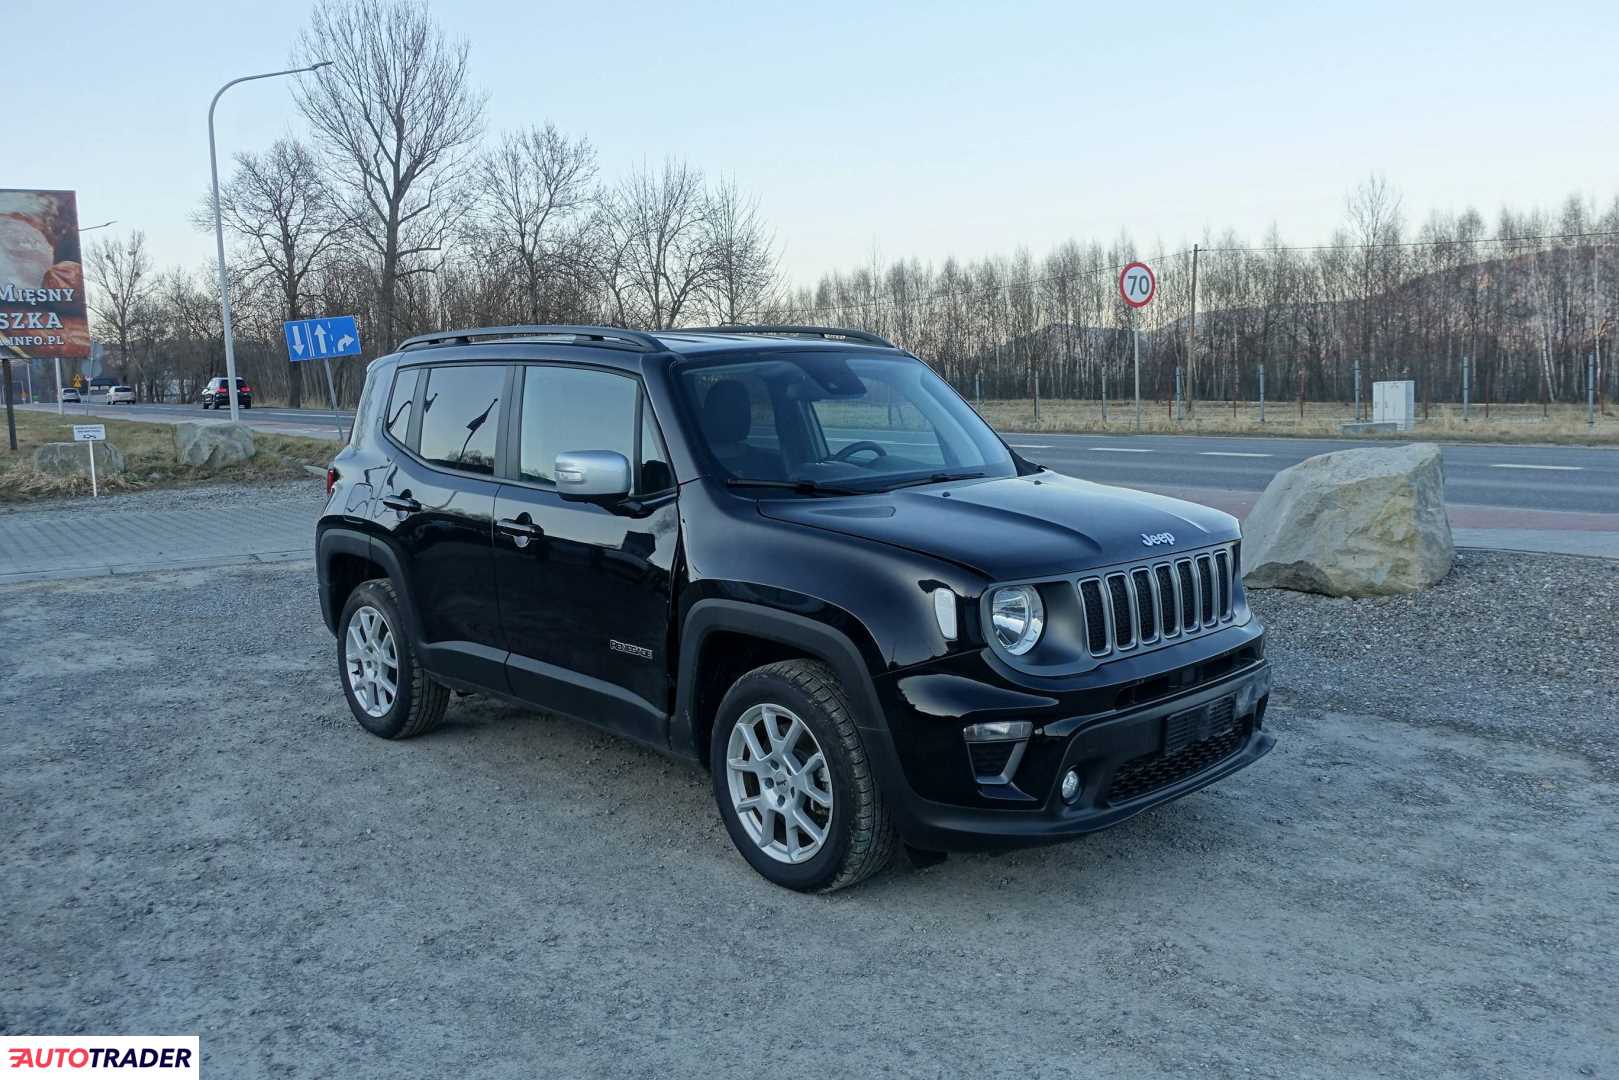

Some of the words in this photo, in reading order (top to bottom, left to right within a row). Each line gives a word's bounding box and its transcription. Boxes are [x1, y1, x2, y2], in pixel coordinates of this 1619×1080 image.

[1127, 275, 1150, 296] 70
[0, 312, 63, 330] SZKA
[1140, 532, 1176, 546] Jeep
